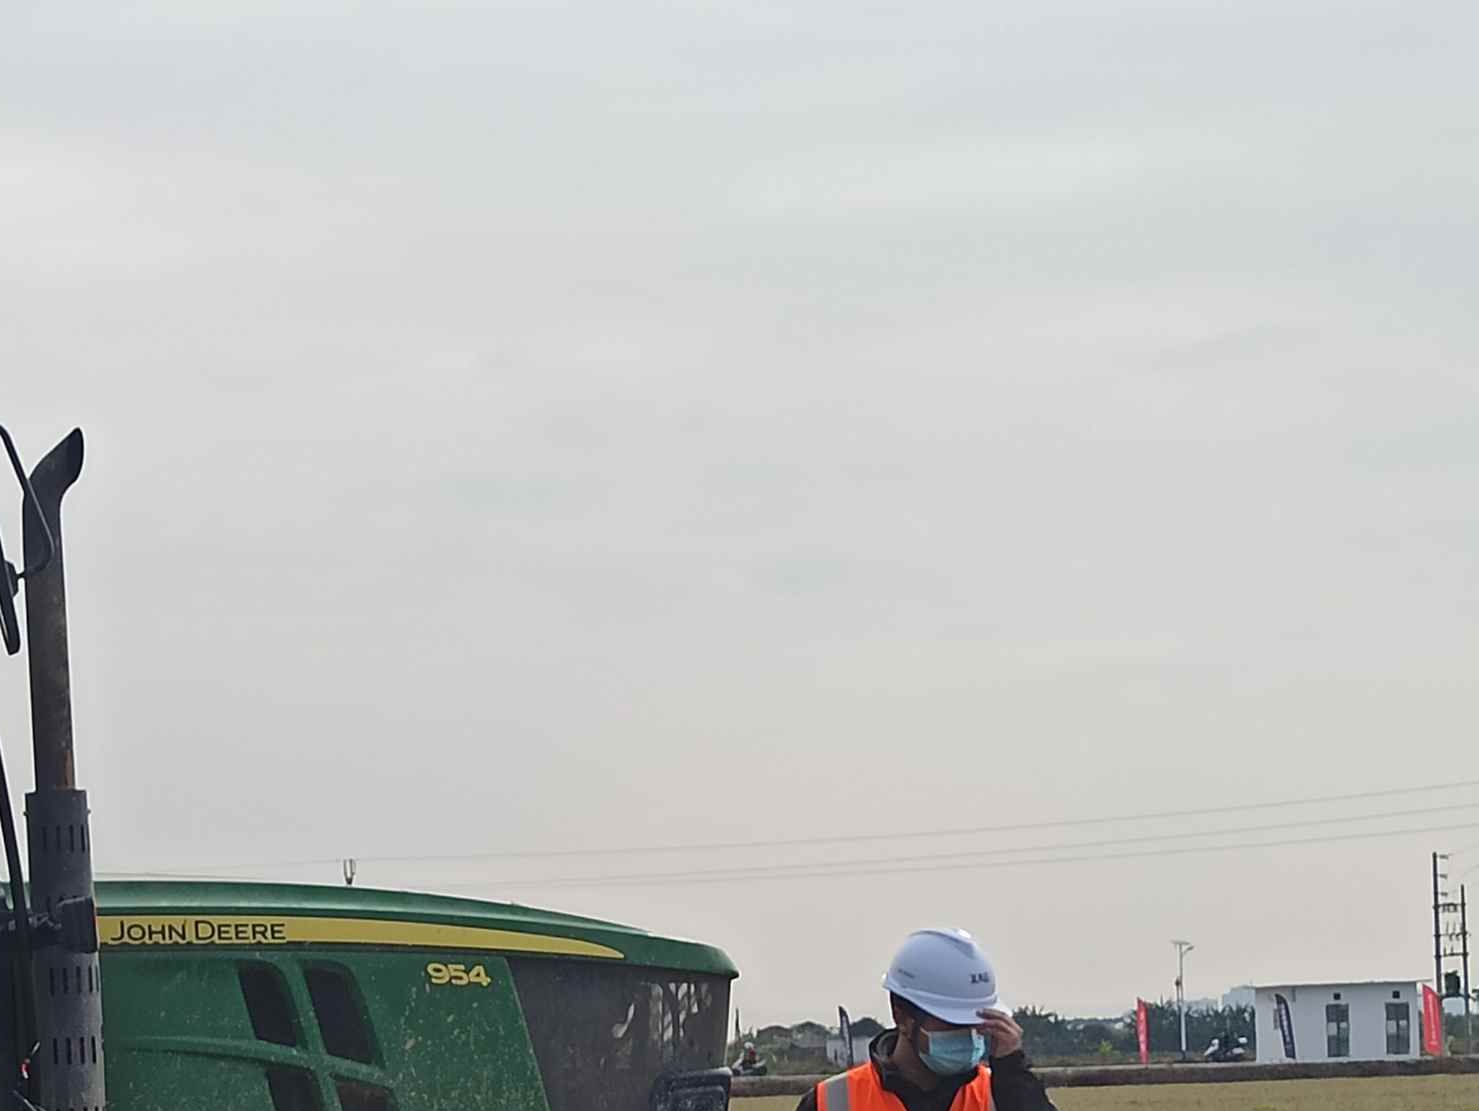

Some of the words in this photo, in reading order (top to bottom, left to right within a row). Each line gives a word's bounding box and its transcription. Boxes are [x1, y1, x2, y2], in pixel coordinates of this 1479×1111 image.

[110, 920, 187, 941] JOHN
[194, 920, 287, 940] DEERE
[426, 962, 492, 987] 954
